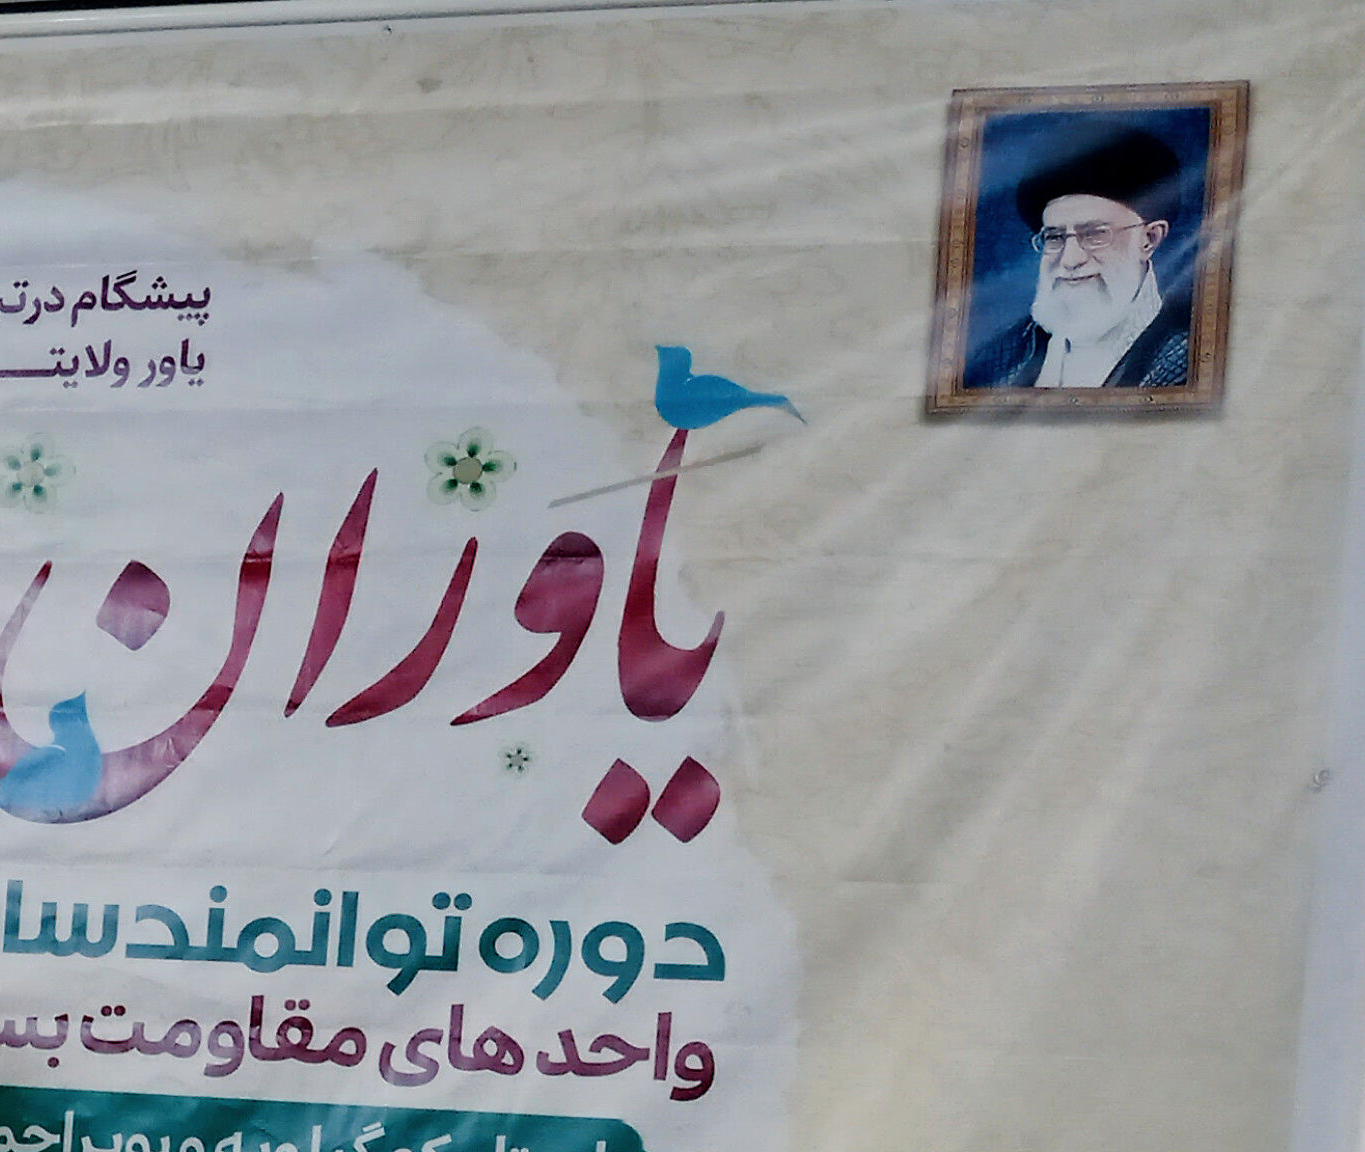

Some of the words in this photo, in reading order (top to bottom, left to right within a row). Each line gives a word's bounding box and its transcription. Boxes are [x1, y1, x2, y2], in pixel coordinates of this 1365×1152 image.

[71, 270, 211, 327] پیشگام
[138, 338, 205, 387] یاور
[479, 916, 726, 1004] دوره
[80, 995, 367, 1077] مقاومت
